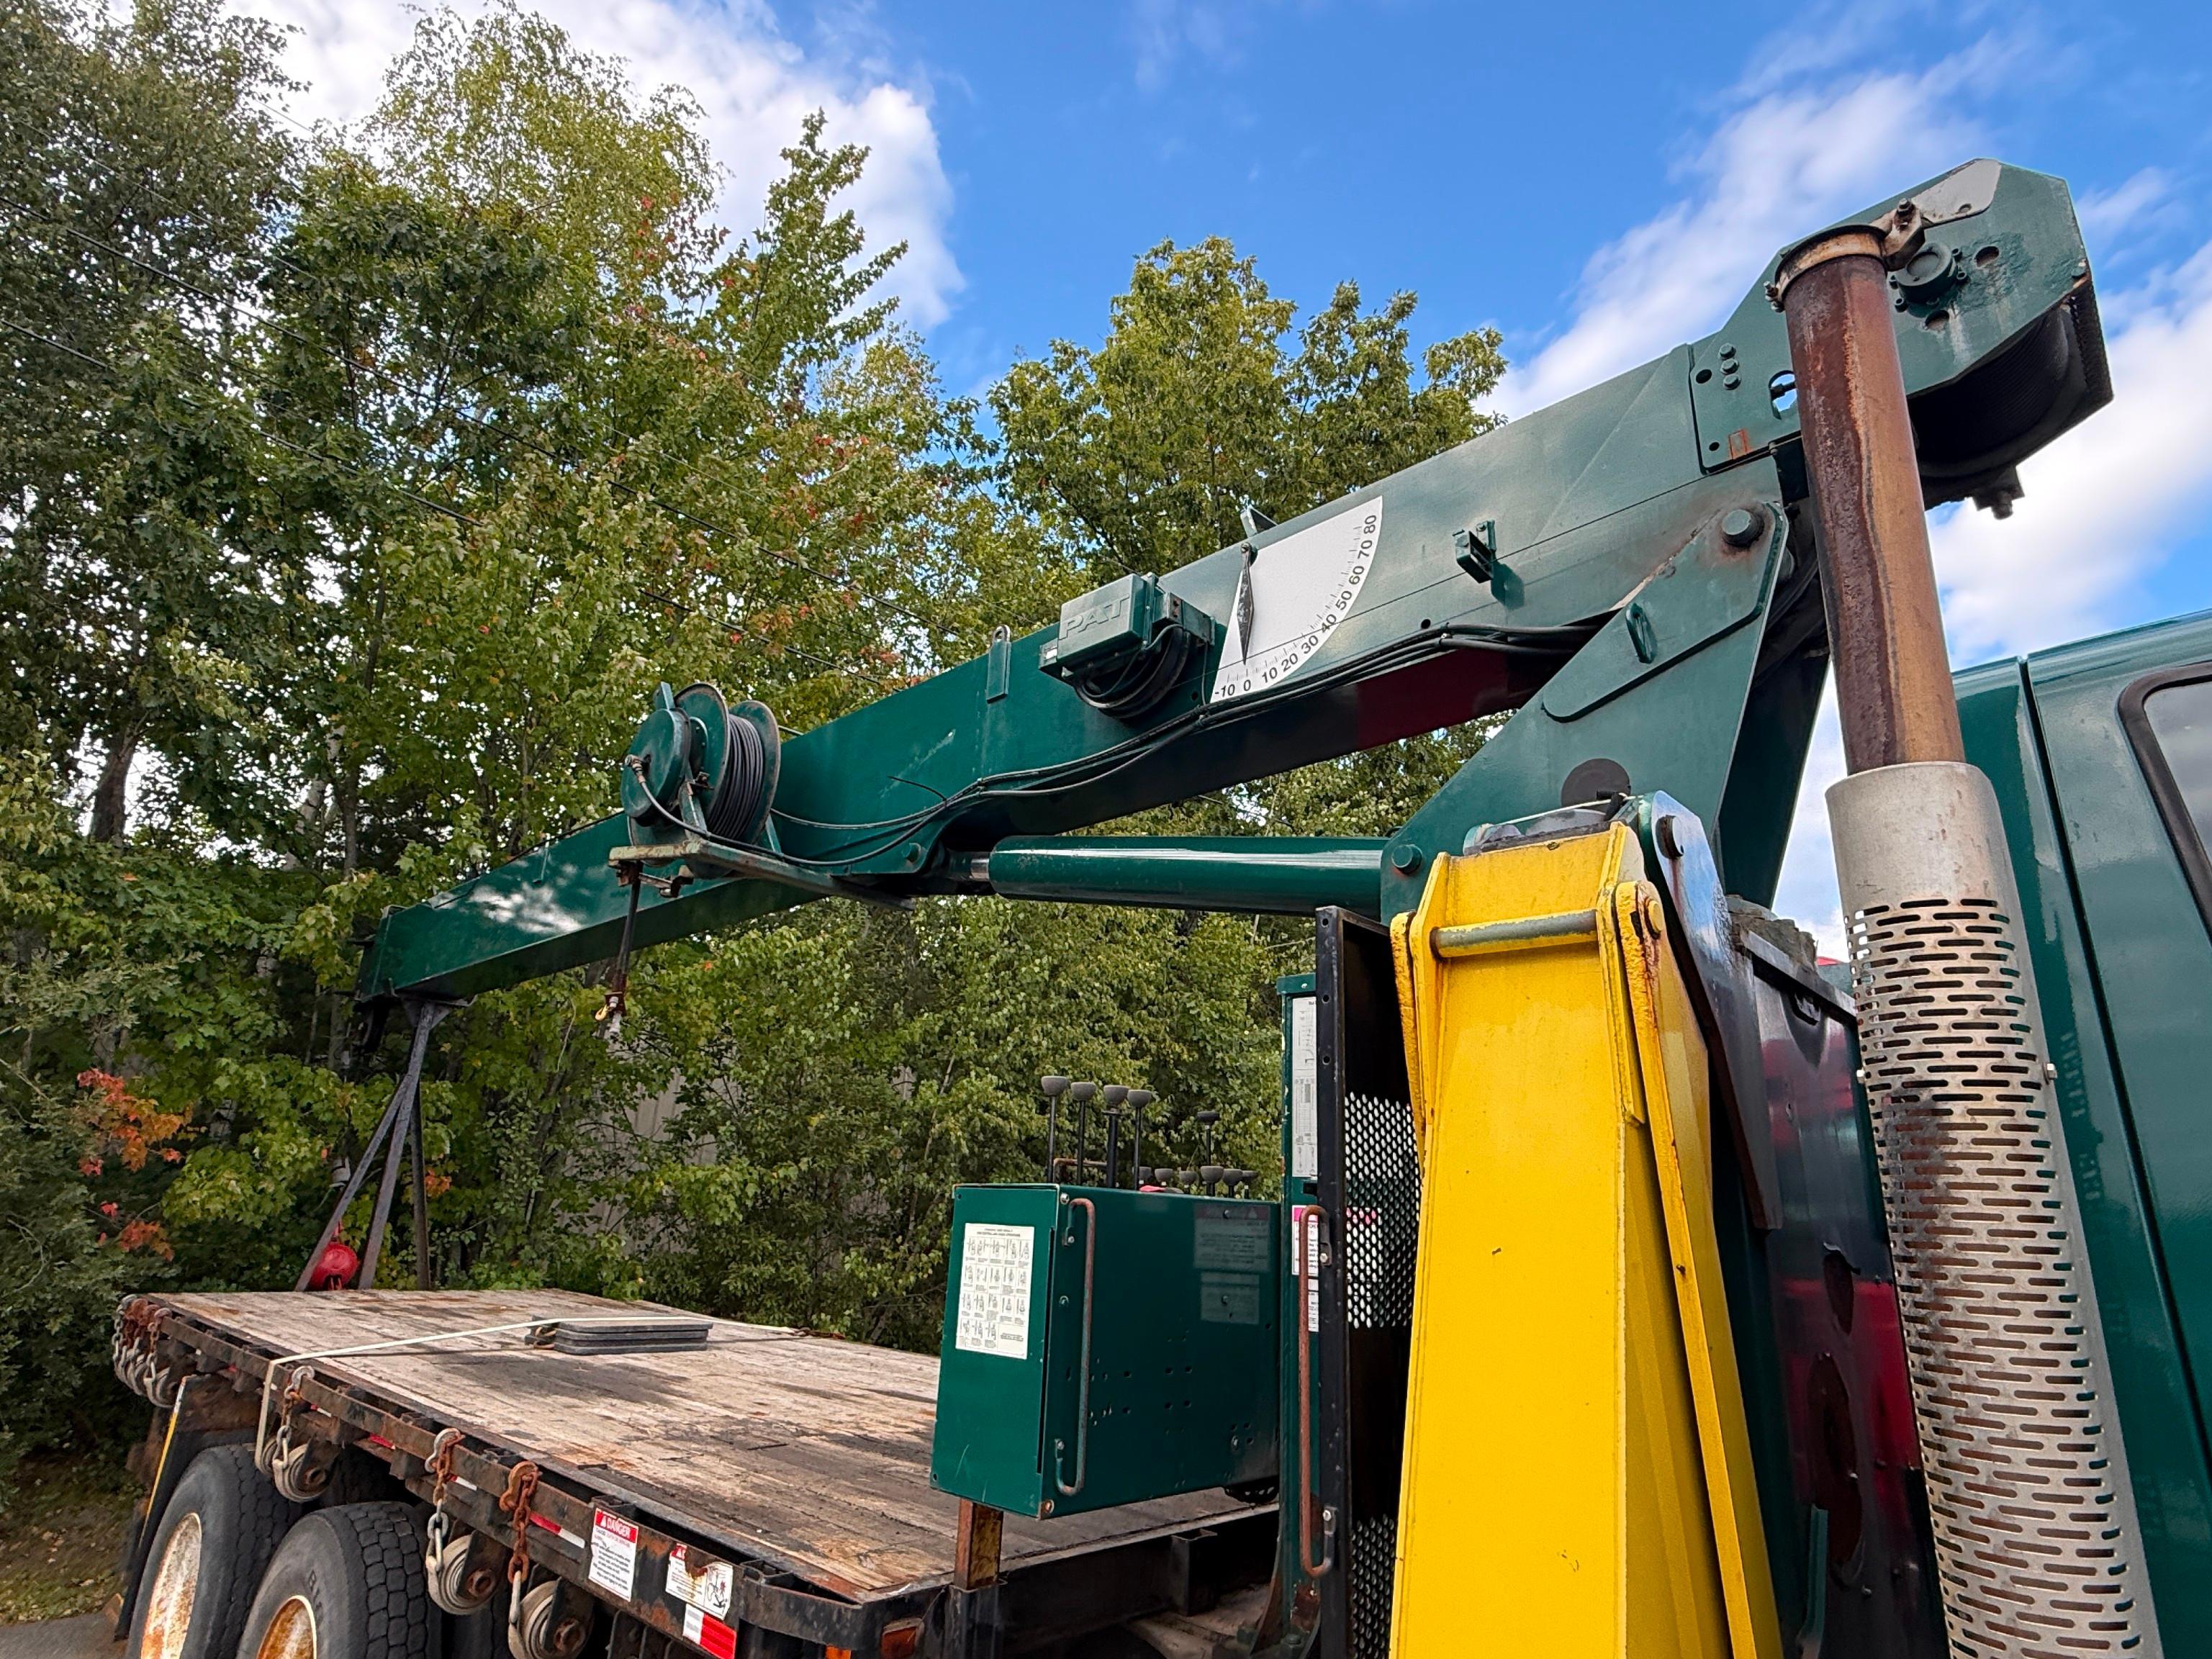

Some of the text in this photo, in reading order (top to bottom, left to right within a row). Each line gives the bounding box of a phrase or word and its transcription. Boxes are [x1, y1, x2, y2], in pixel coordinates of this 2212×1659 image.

[1059, 593, 1129, 640] PAT
[1214, 515, 1377, 697] -10 0 10 20 30 40 50 60 70 80
[607, 1517, 631, 1540] DANGER
